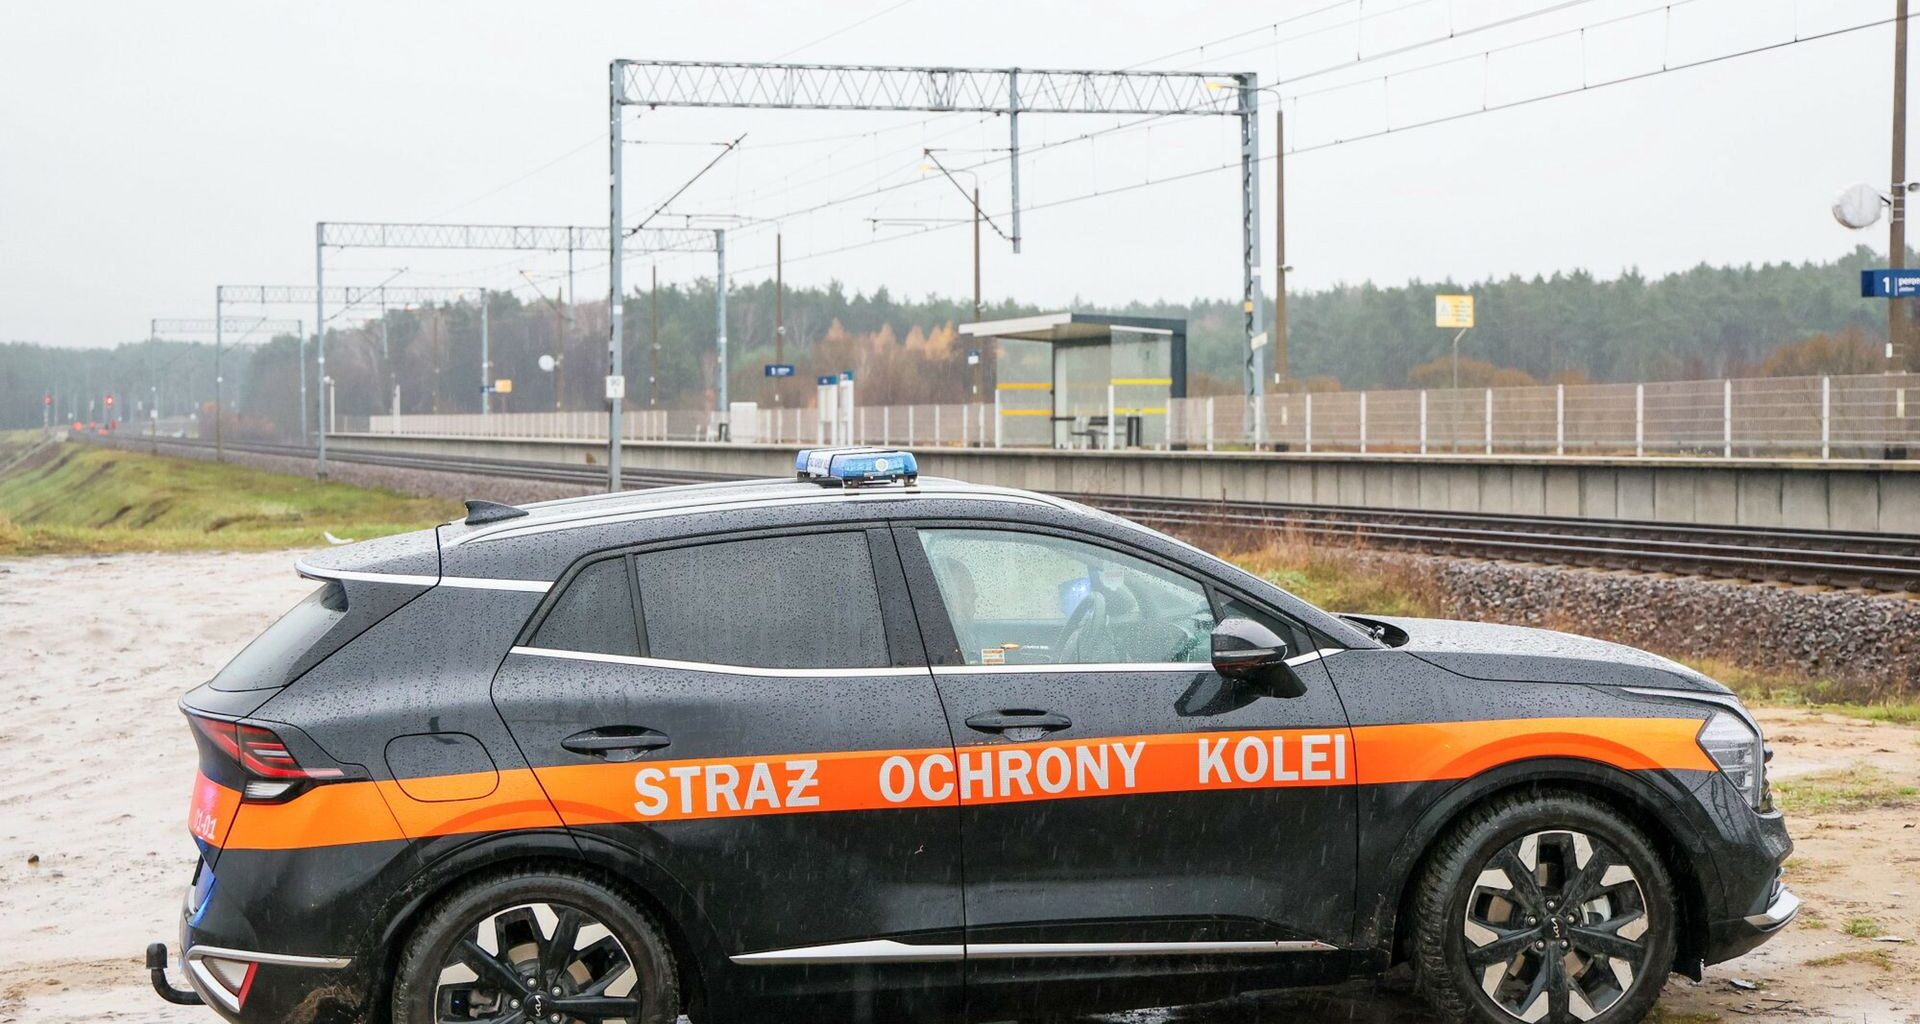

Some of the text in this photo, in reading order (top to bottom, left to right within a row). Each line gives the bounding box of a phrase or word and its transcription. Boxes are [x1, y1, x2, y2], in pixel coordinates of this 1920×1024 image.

[1882, 276, 1890, 294] 1
[879, 741, 1146, 803] OCHRONY
[1198, 734, 1346, 784] KOLEI
